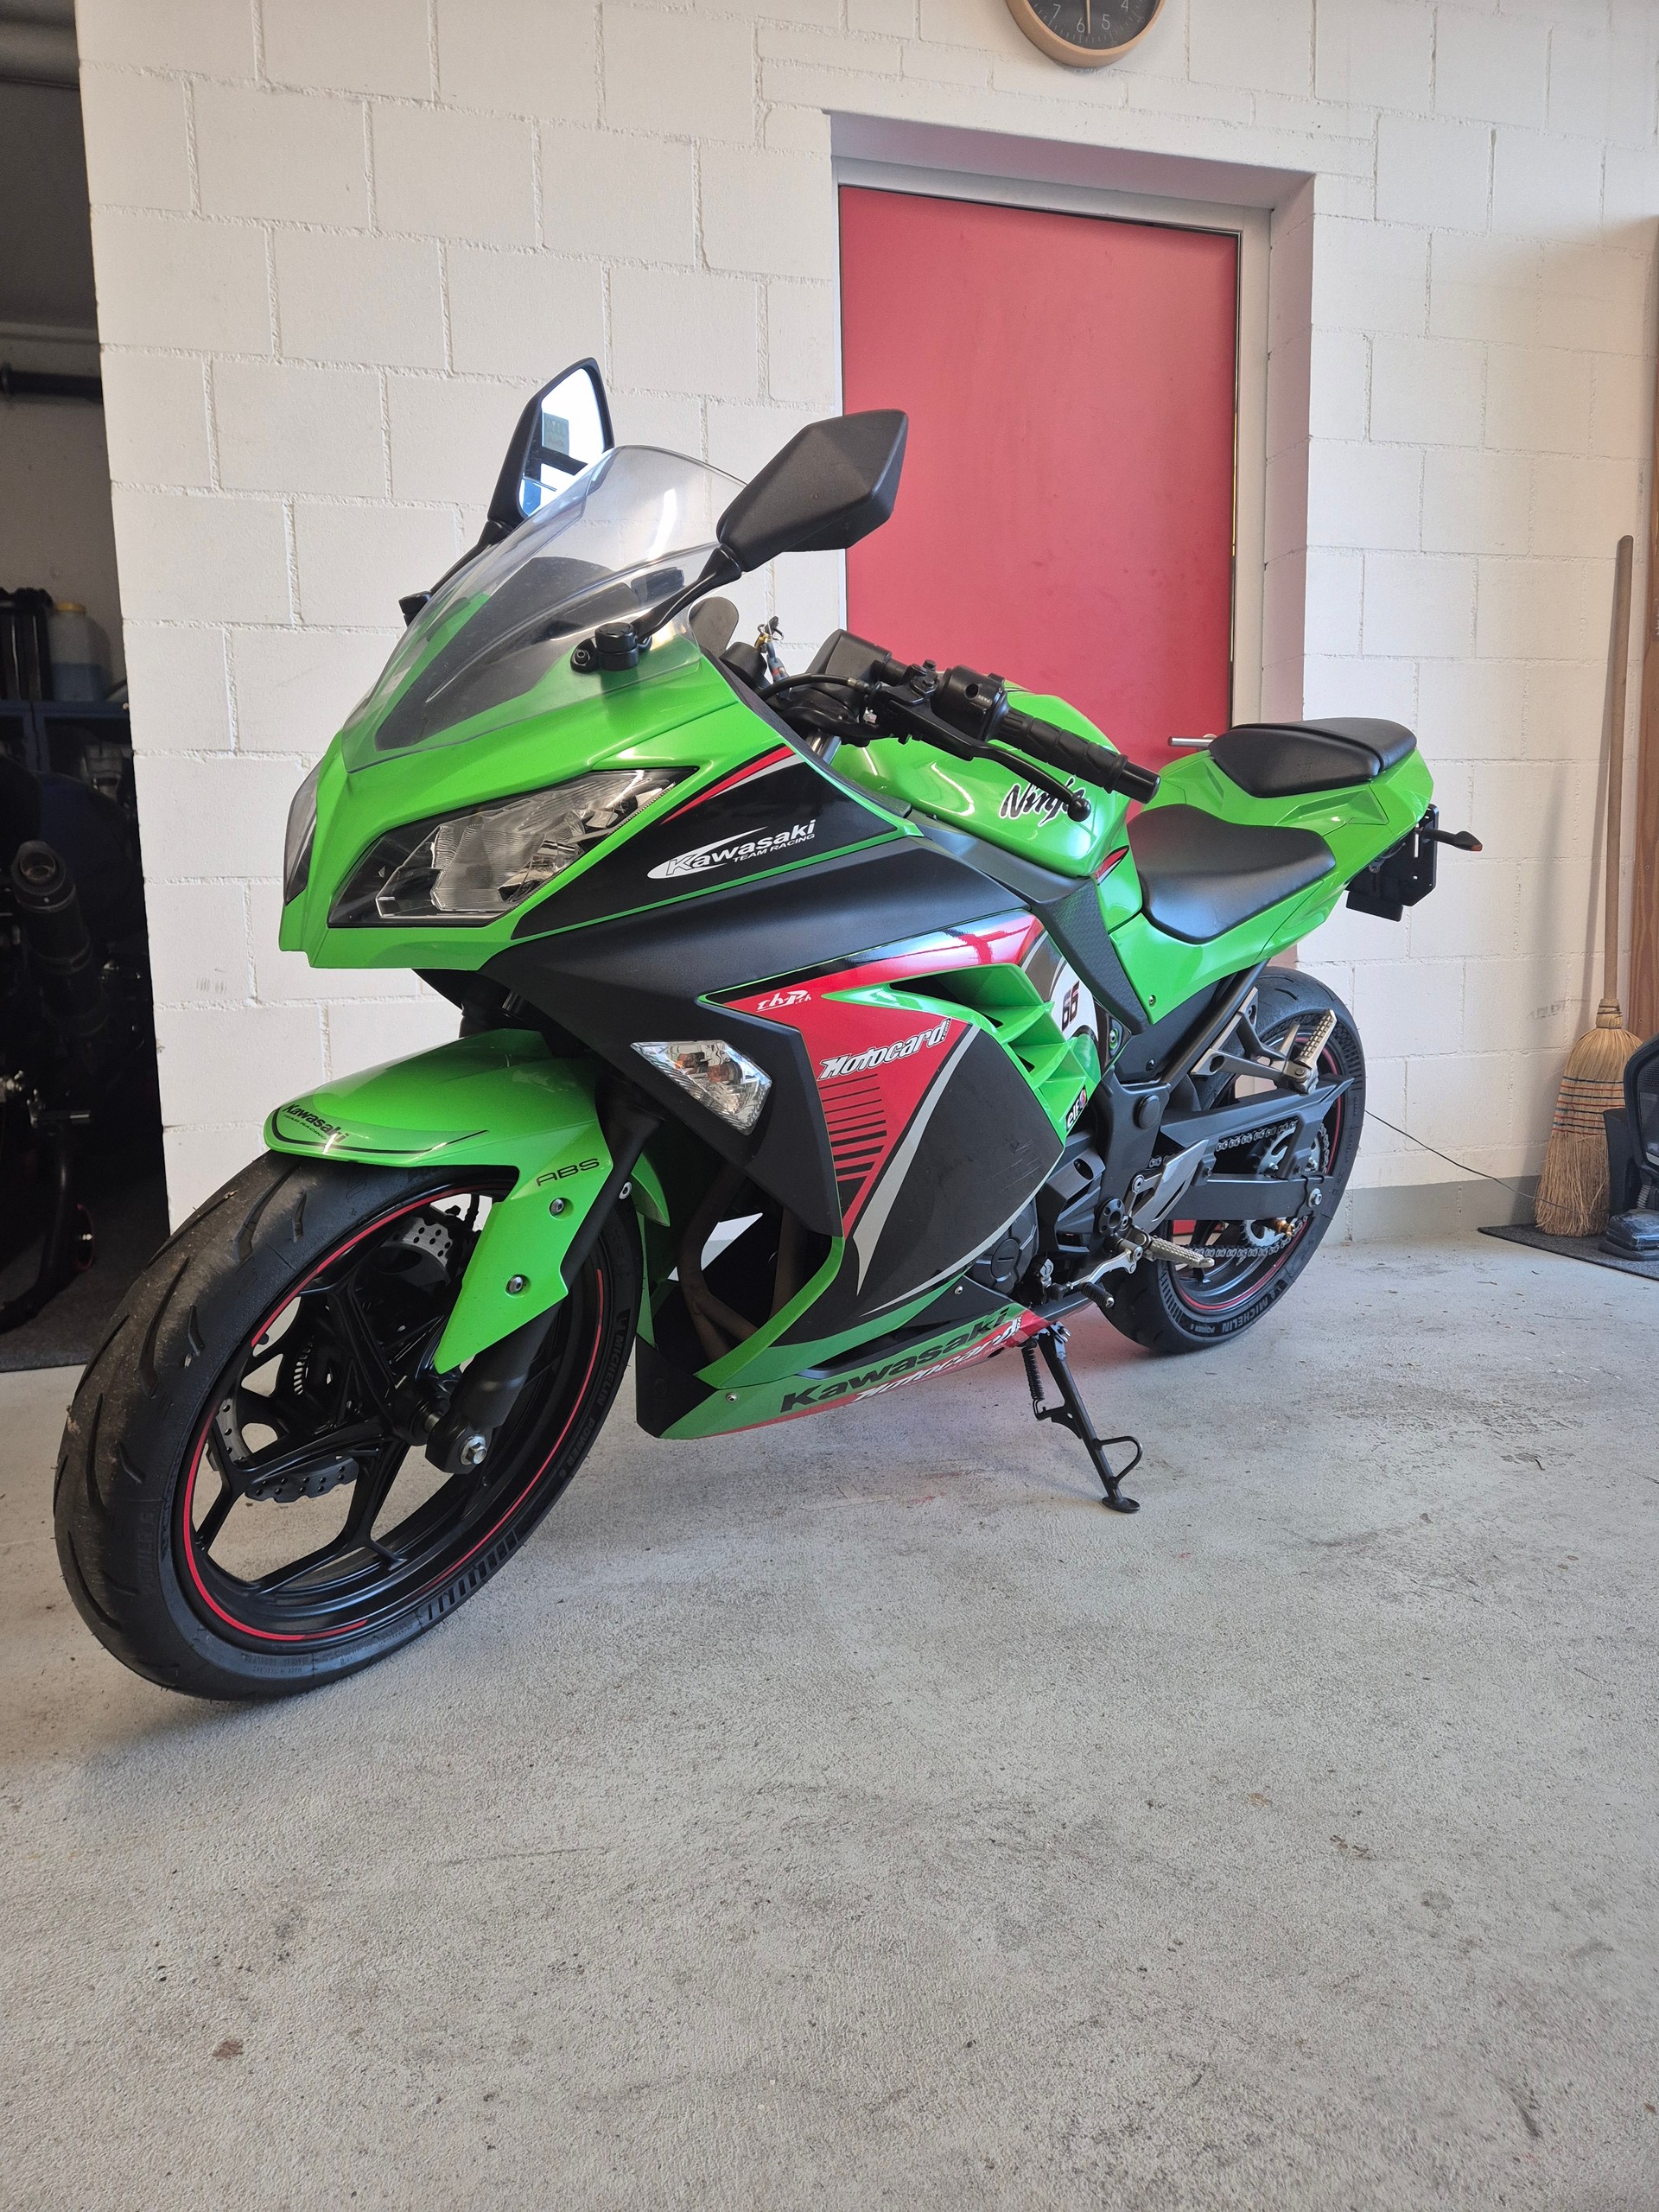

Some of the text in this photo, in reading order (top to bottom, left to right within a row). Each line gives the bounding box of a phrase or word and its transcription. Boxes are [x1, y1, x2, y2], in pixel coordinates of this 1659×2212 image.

[1052, 3, 1061, 19] 7
[1121, 0, 1129, 12] 4
[1076, 16, 1085, 33] 6
[1101, 14, 1110, 30] 5
[665, 819, 817, 876] Kawasaki
[733, 833, 815, 862] TEAM RACING
[1067, 1098, 1080, 1128] elf
[536, 1158, 600, 1187] ABS
[1221, 1296, 1268, 1333] MICHELIN
[597, 1333, 625, 1408] MICHELIN
[780, 1306, 1009, 1413] Kawasaki
[567, 1416, 596, 1465] POWER
